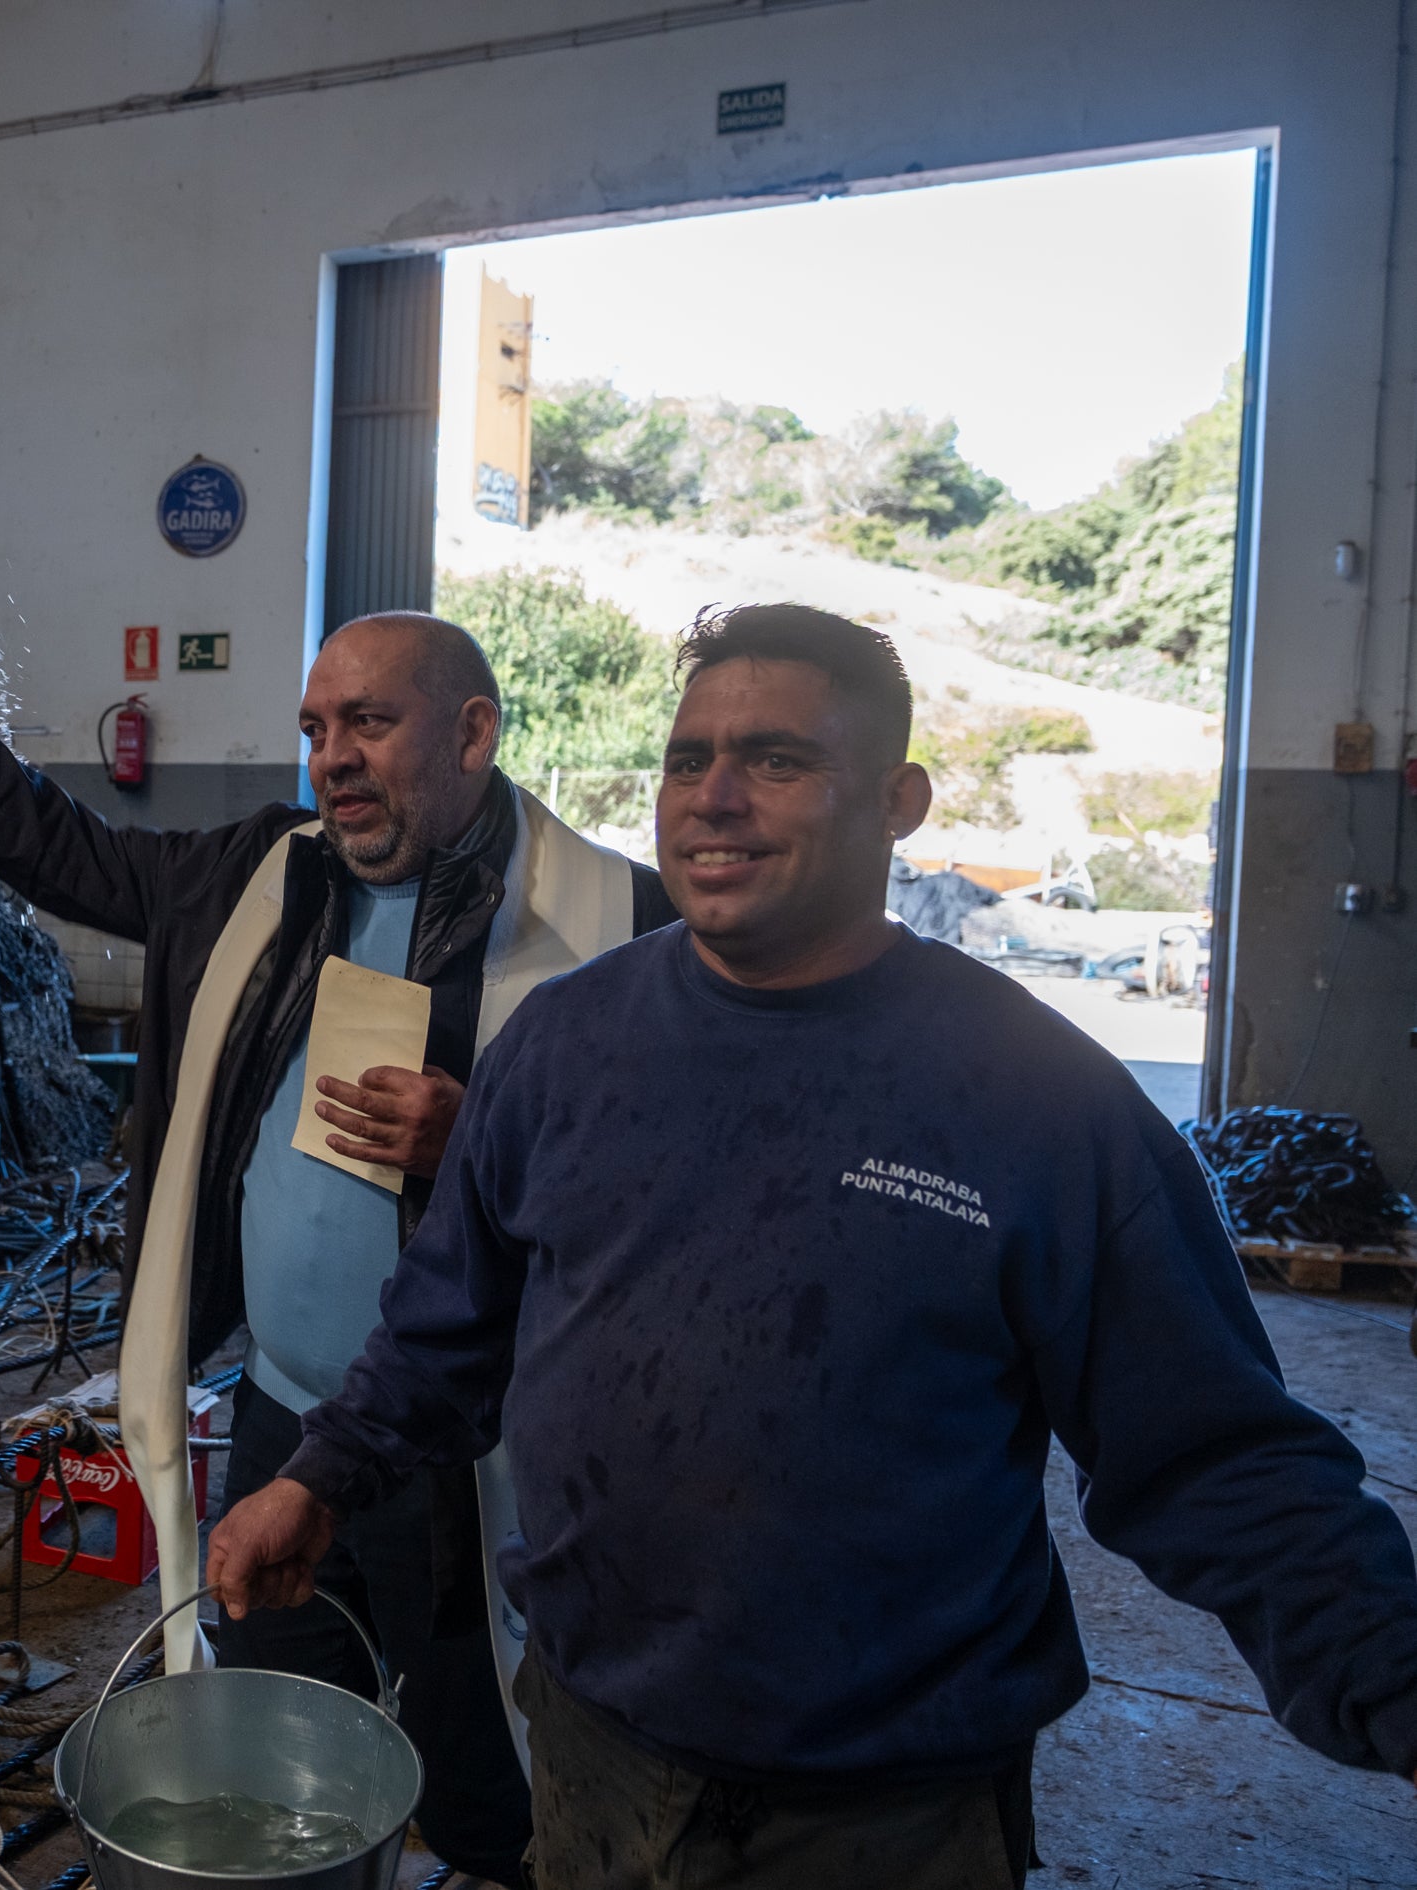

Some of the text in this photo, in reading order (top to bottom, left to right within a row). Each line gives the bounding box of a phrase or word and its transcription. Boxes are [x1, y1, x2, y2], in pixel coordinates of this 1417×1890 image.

[167, 509, 232, 531] GADIRA
[841, 1171, 990, 1229] PUNTA ATALAYA
[861, 1157, 982, 1207] ALMADRABA
